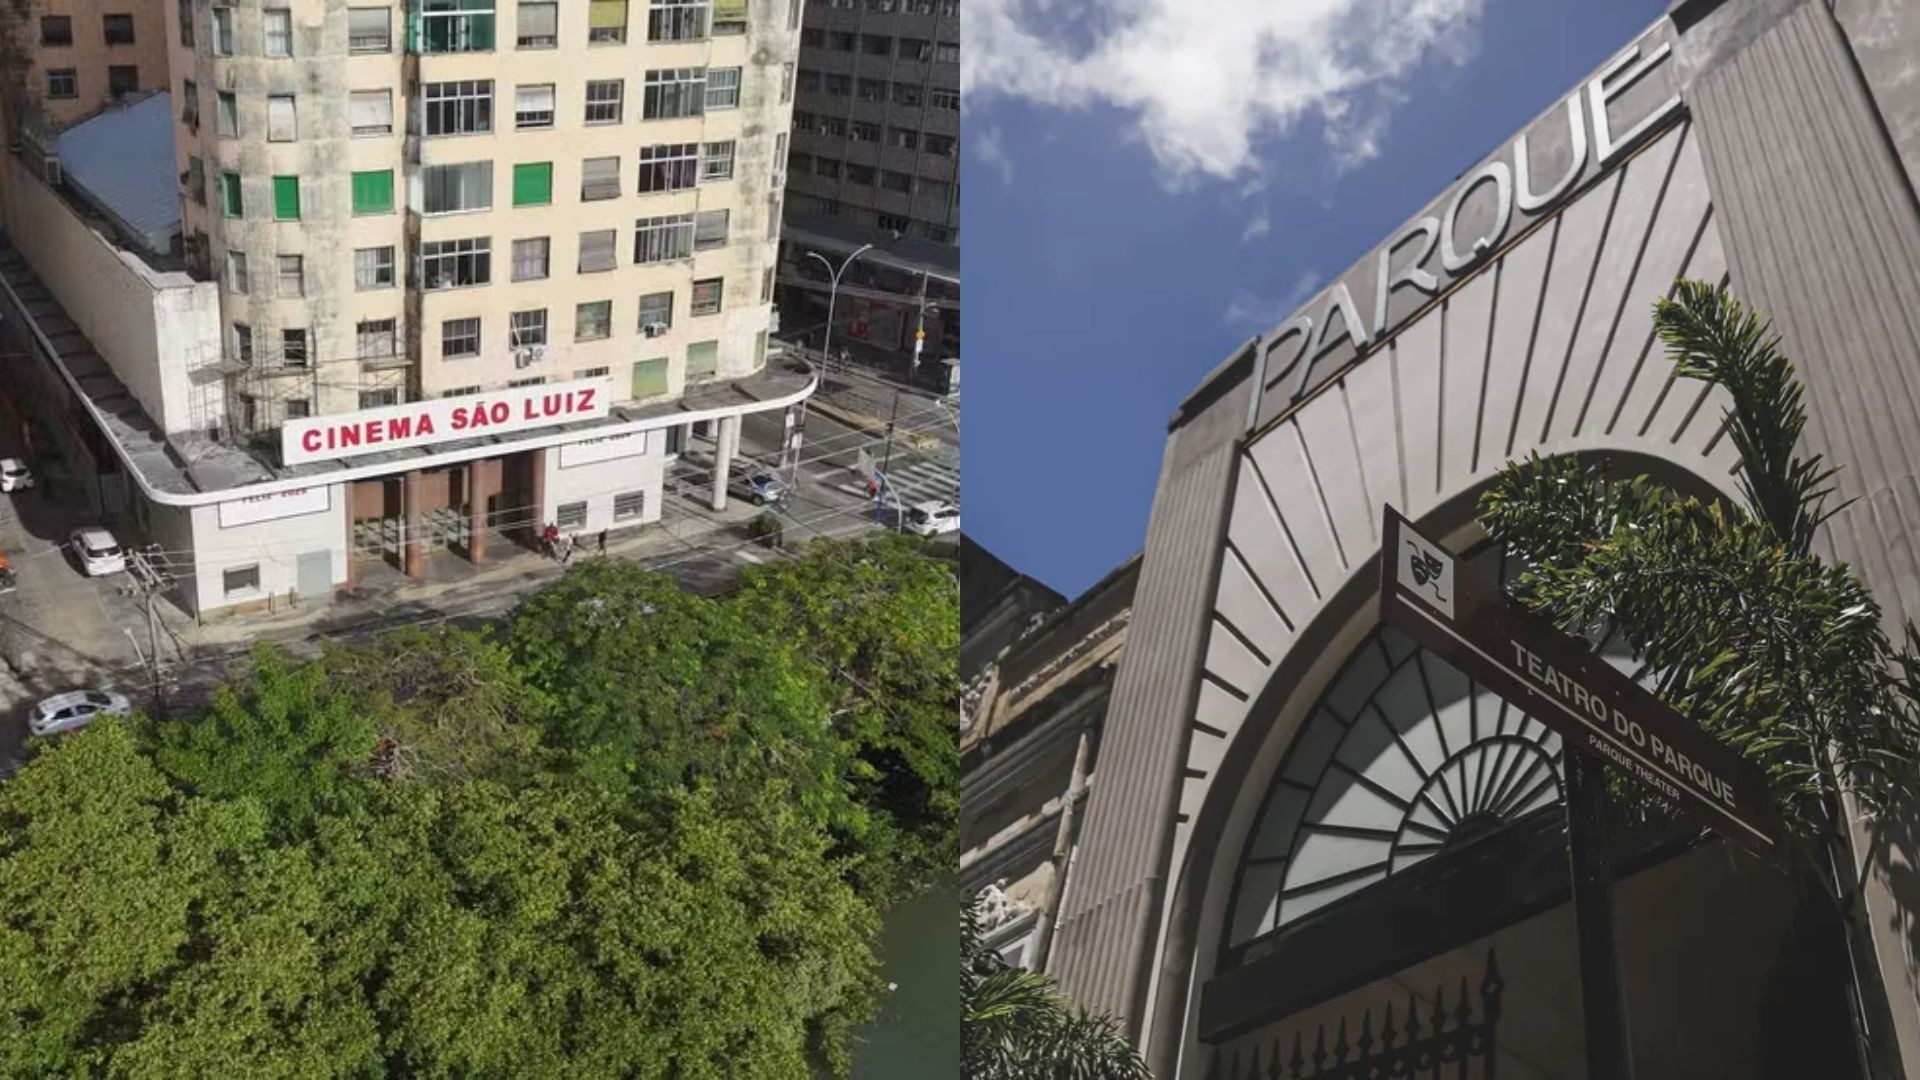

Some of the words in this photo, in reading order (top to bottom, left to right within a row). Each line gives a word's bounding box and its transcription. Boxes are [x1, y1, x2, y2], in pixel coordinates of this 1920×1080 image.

[1246, 40, 1685, 434] PARQUE
[302, 413, 435, 453] CINEMA
[451, 401, 511, 431] SÃO
[523, 388, 597, 420] LUIZ
[1510, 639, 1608, 722] TEATRO
[1613, 708, 1646, 749] DO
[1650, 733, 1737, 809] PARQUE
[1589, 734, 1634, 771] PARQUE
[1635, 763, 1680, 801] THEATER
